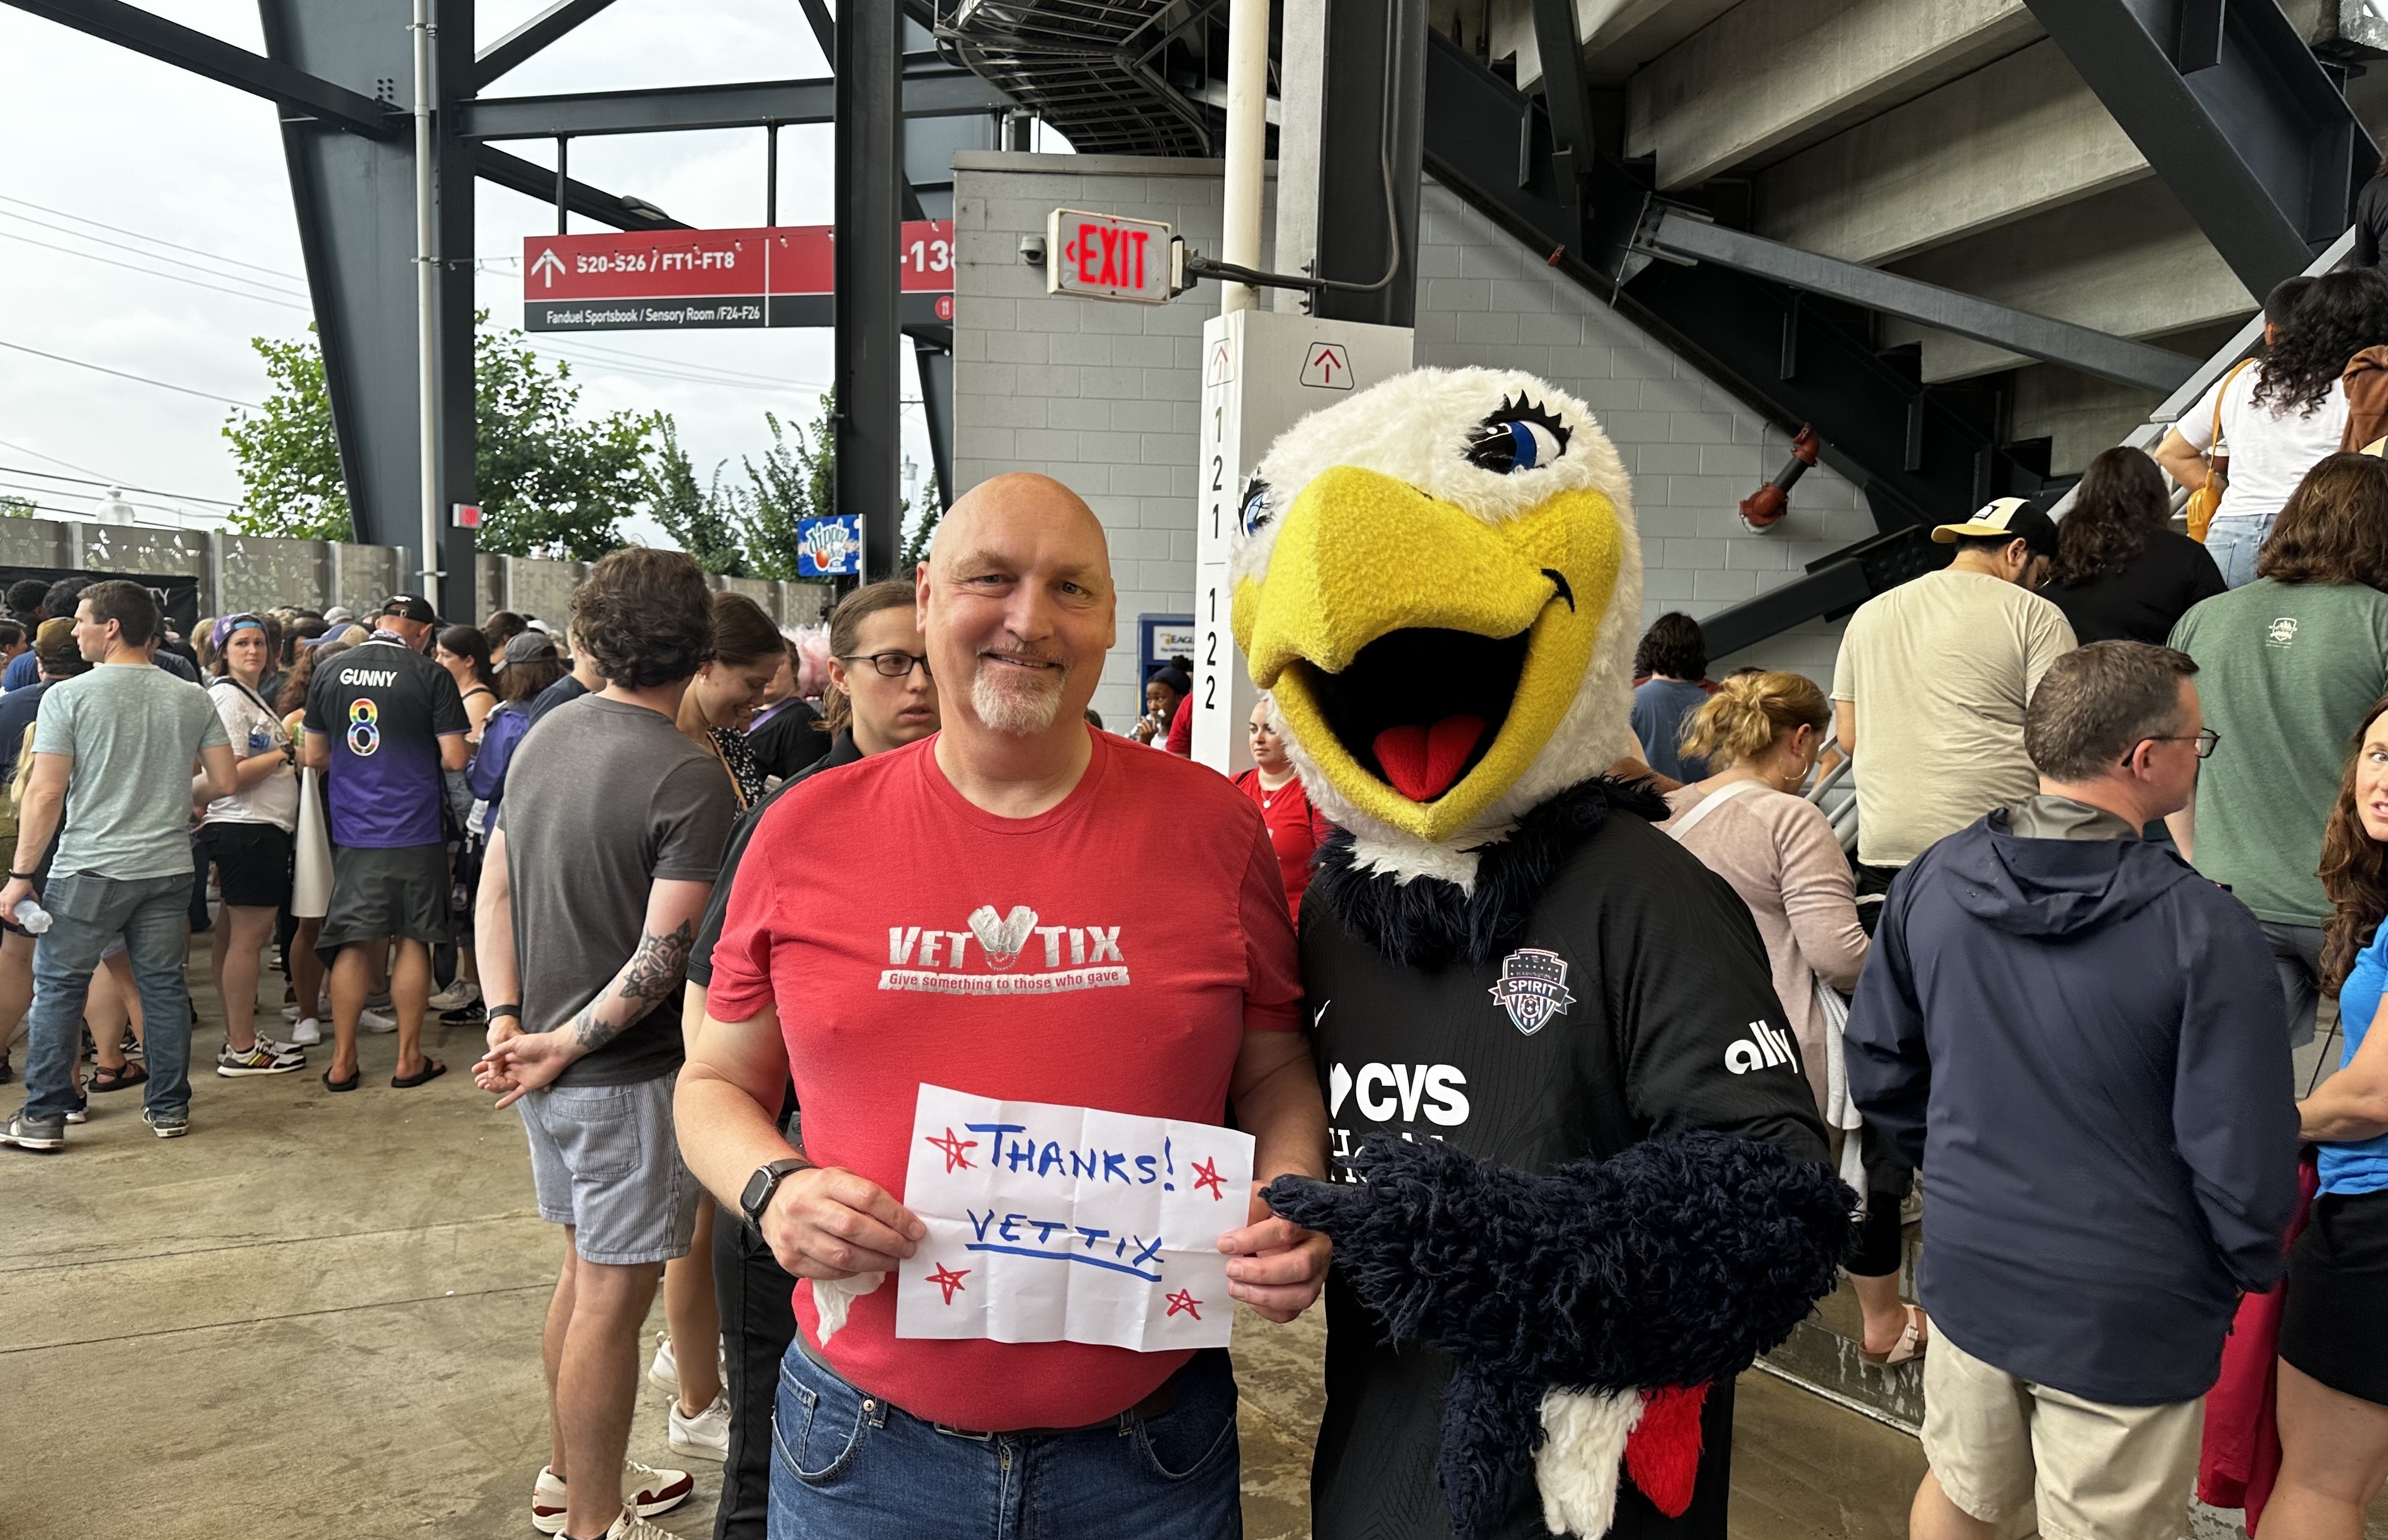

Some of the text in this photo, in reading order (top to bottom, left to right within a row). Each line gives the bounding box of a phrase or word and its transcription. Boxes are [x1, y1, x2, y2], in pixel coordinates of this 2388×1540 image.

[577, 255, 647, 273] S20-S26
[663, 252, 736, 271] FT1-FT8
[1079, 224, 1149, 290] EXIT
[546, 310, 584, 324] Fanduel
[585, 308, 638, 326] Sportsbook
[646, 307, 686, 323] Sensory
[687, 307, 715, 320] Room
[340, 668, 397, 687] GUNNY
[347, 698, 380, 756] 8
[888, 925, 1125, 970] VET TIX
[889, 971, 1119, 992] Give something to those who gave
[1508, 980, 1558, 997] SPIRIT
[1725, 1020, 1798, 1074] ally
[1356, 1063, 1469, 1125] CVS
[964, 1122, 1175, 1191] THANKS!
